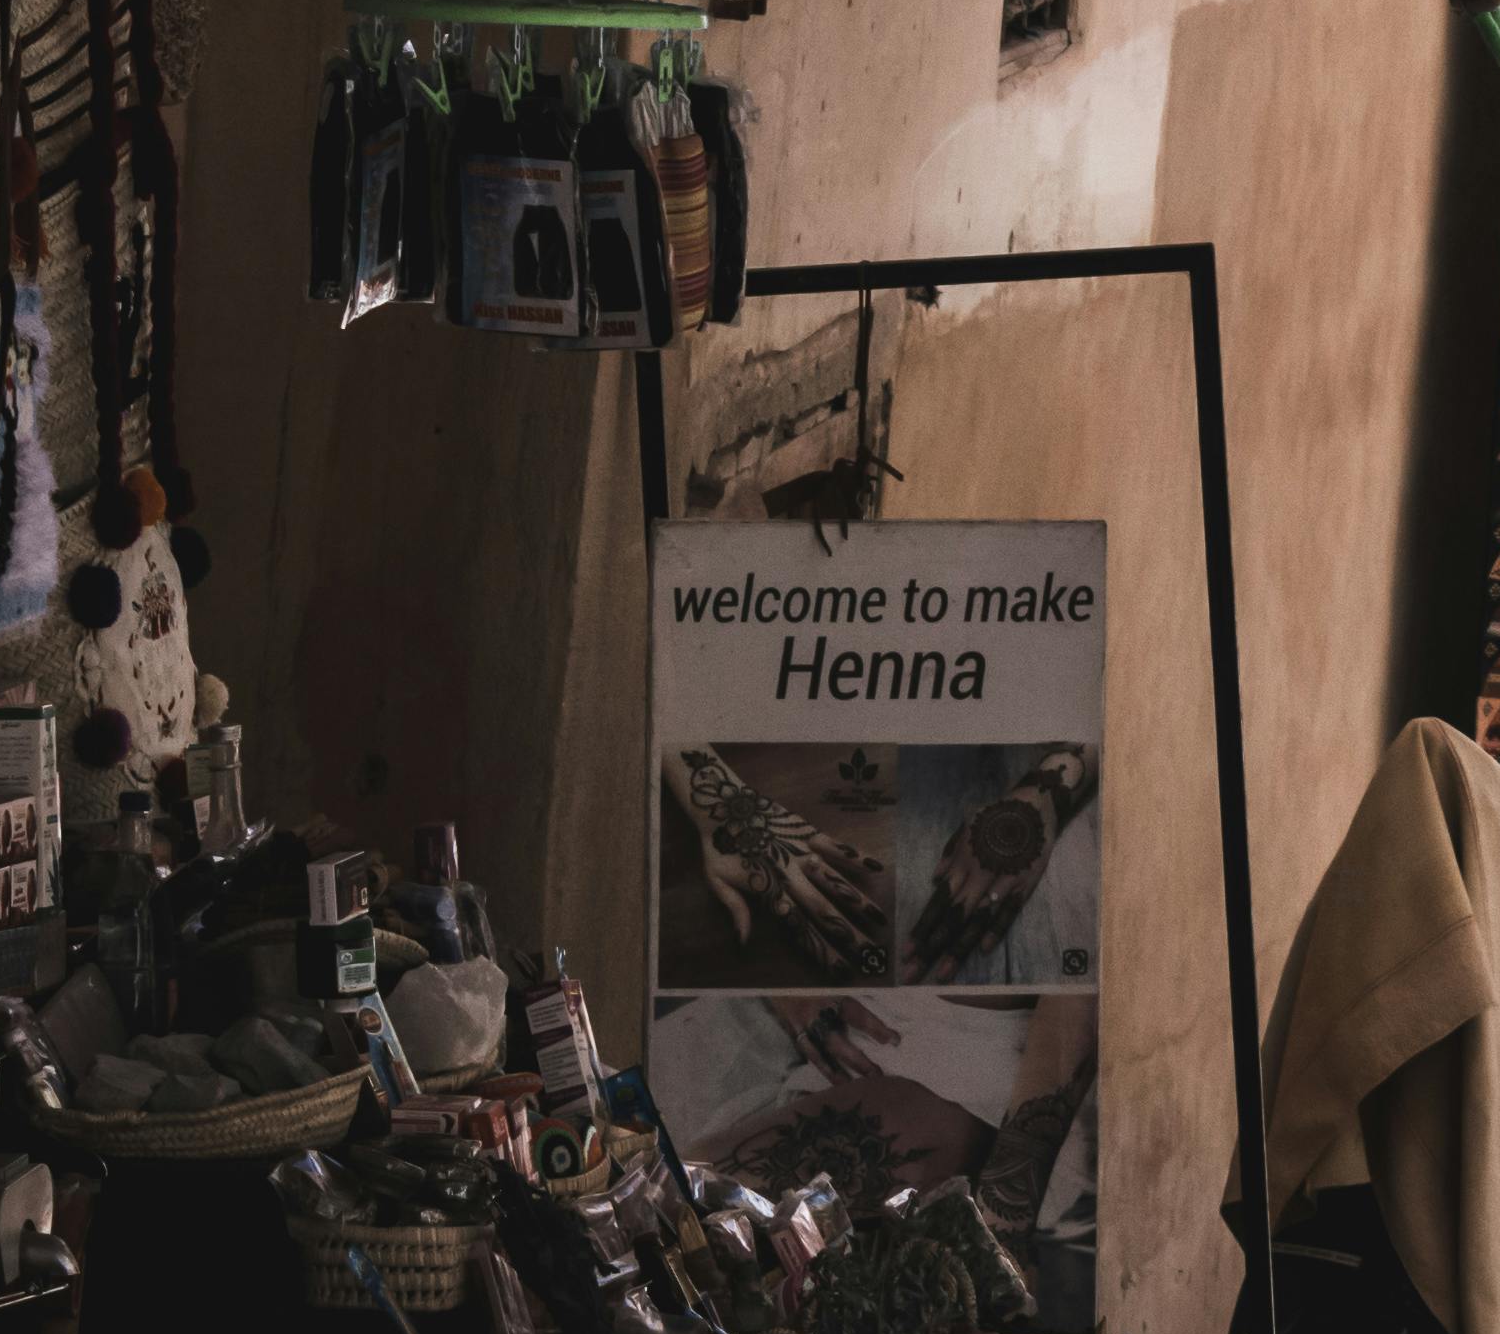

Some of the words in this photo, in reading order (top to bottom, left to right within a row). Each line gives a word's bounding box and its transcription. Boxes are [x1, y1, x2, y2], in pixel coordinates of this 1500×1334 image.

[673, 572, 887, 624] welcome
[902, 578, 949, 624] to
[963, 571, 1095, 623] make
[775, 635, 986, 701] Henna
